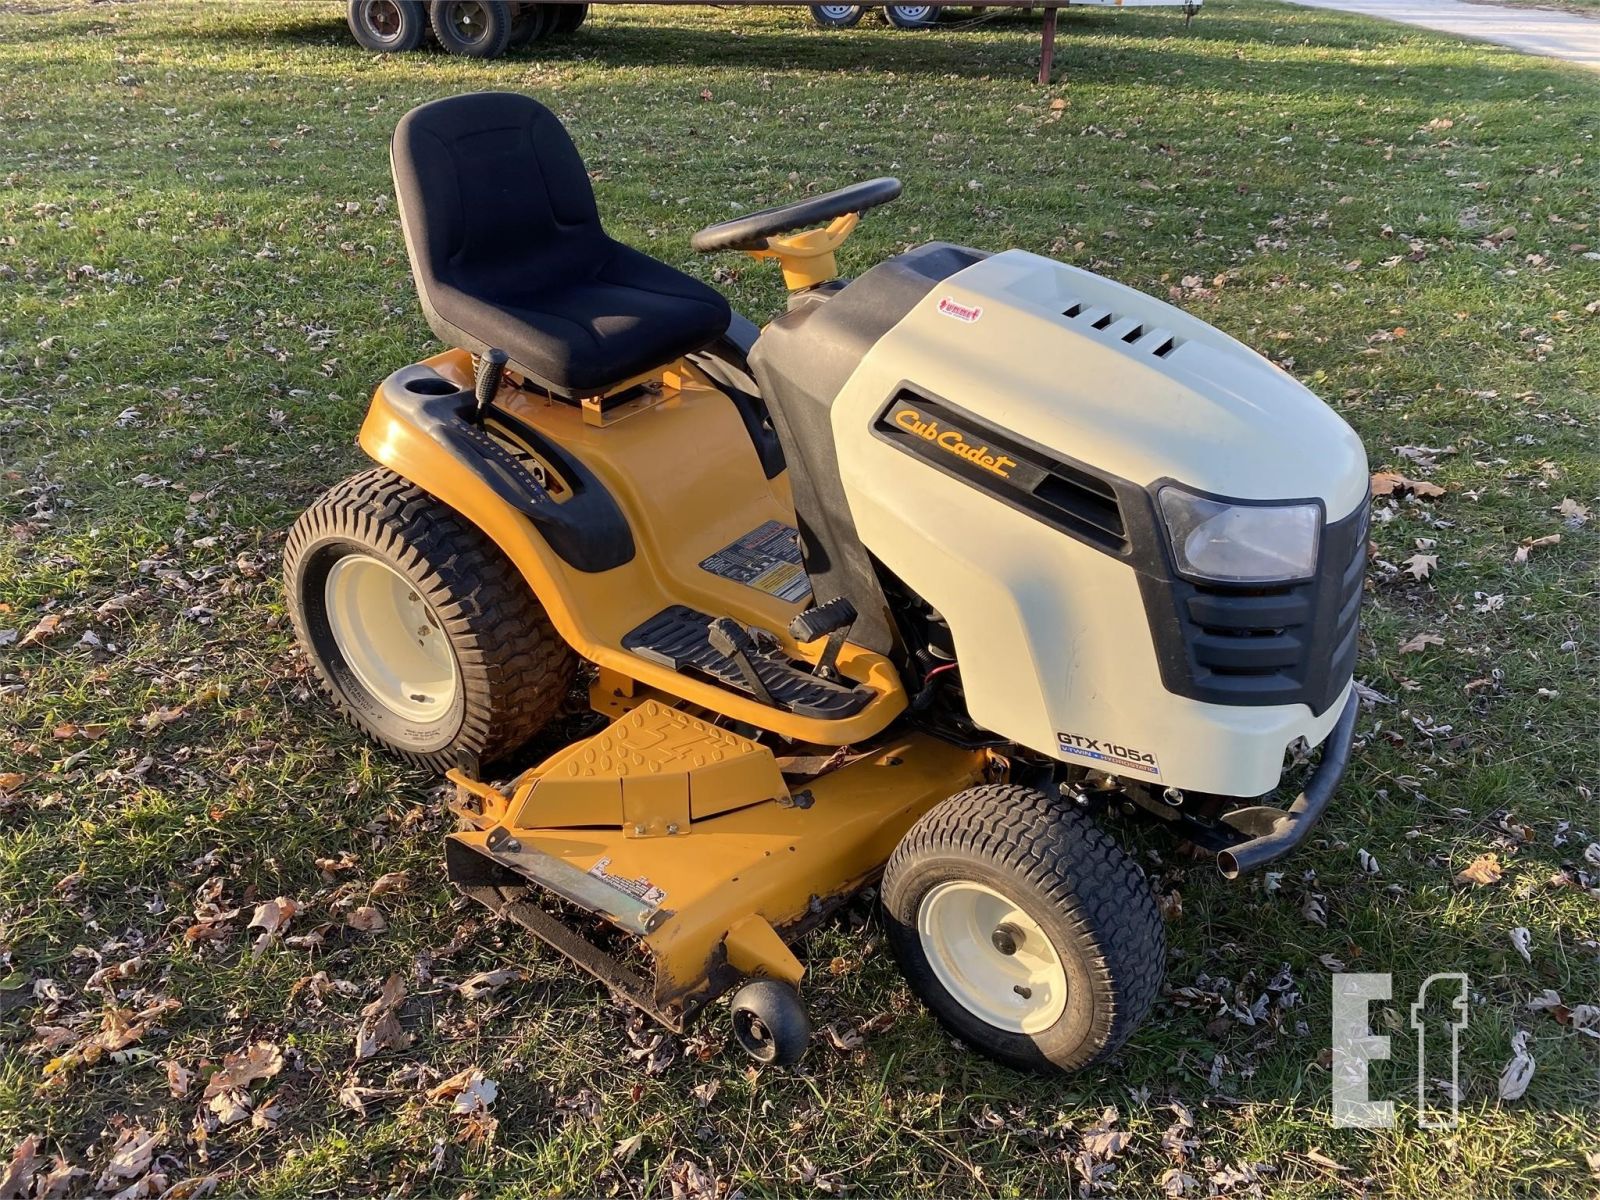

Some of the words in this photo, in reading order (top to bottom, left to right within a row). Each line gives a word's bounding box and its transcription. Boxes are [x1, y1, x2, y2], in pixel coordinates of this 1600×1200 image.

[895, 410, 938, 440] Cub
[937, 431, 1017, 479] Cadet
[1057, 732, 1100, 751] GTX
[1103, 743, 1155, 765] 1054
